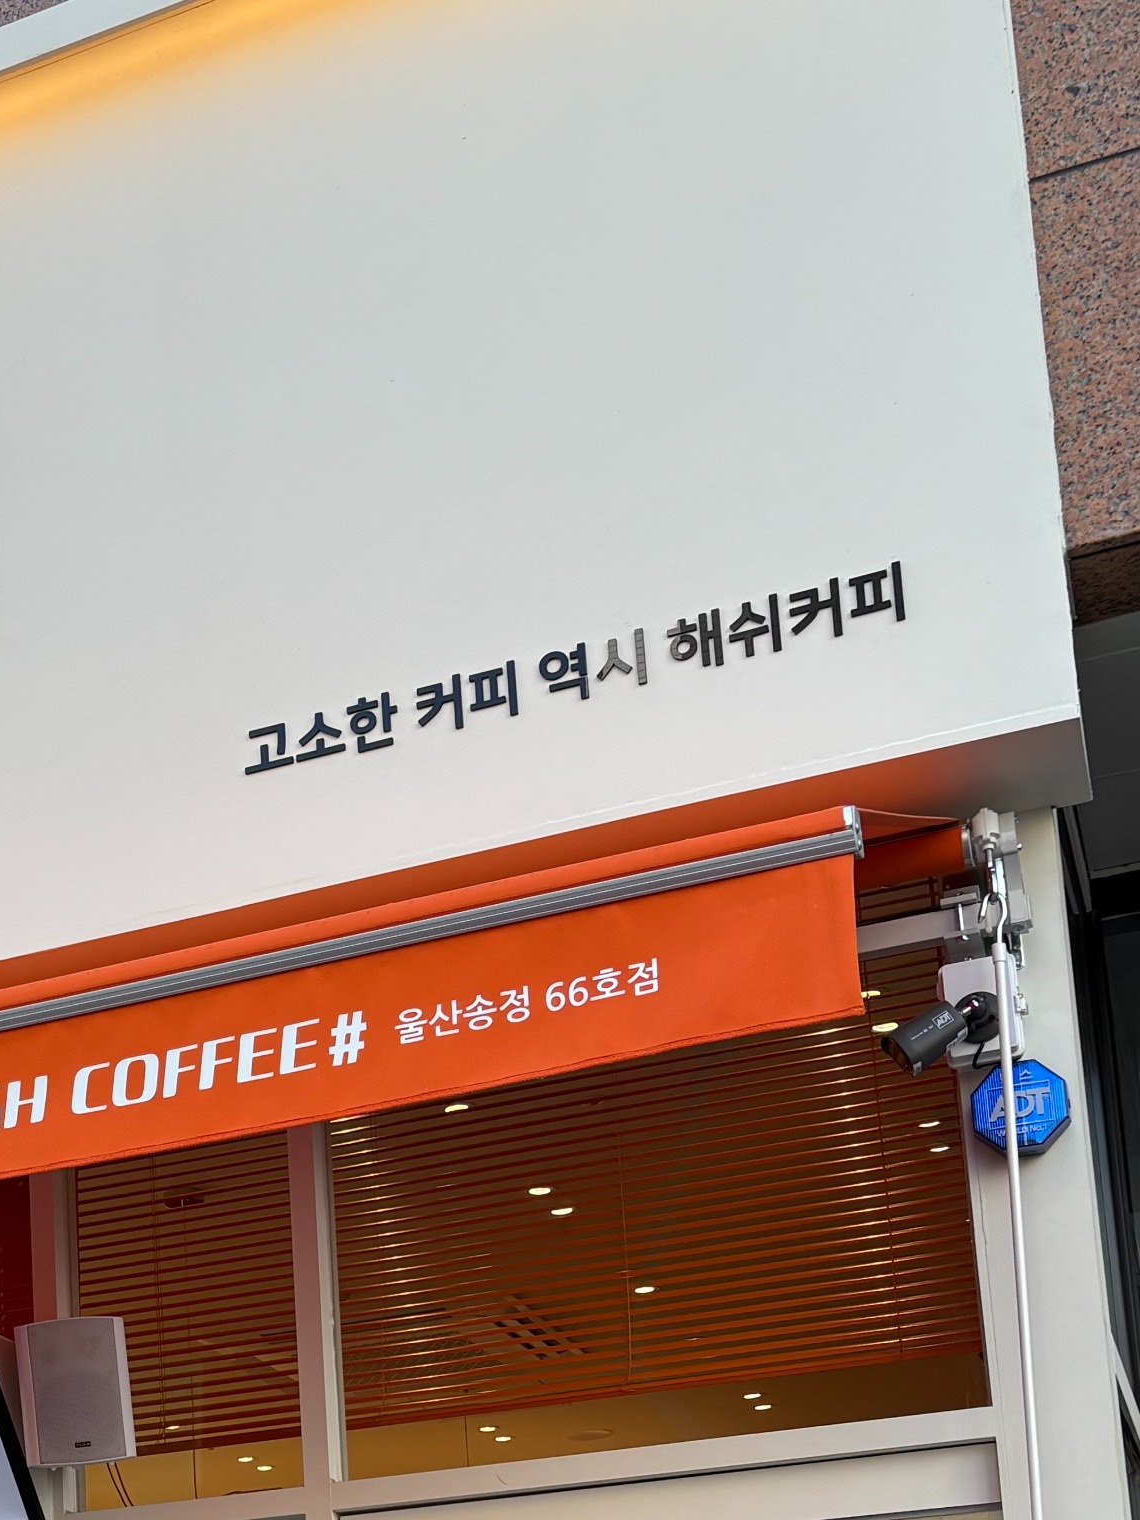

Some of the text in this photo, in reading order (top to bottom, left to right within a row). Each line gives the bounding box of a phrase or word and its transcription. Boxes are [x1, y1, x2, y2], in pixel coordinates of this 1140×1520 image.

[245, 561, 906, 774] 고소한 커피 역시 해쉬커피
[394, 957, 660, 1045] 울산송정 66호점
